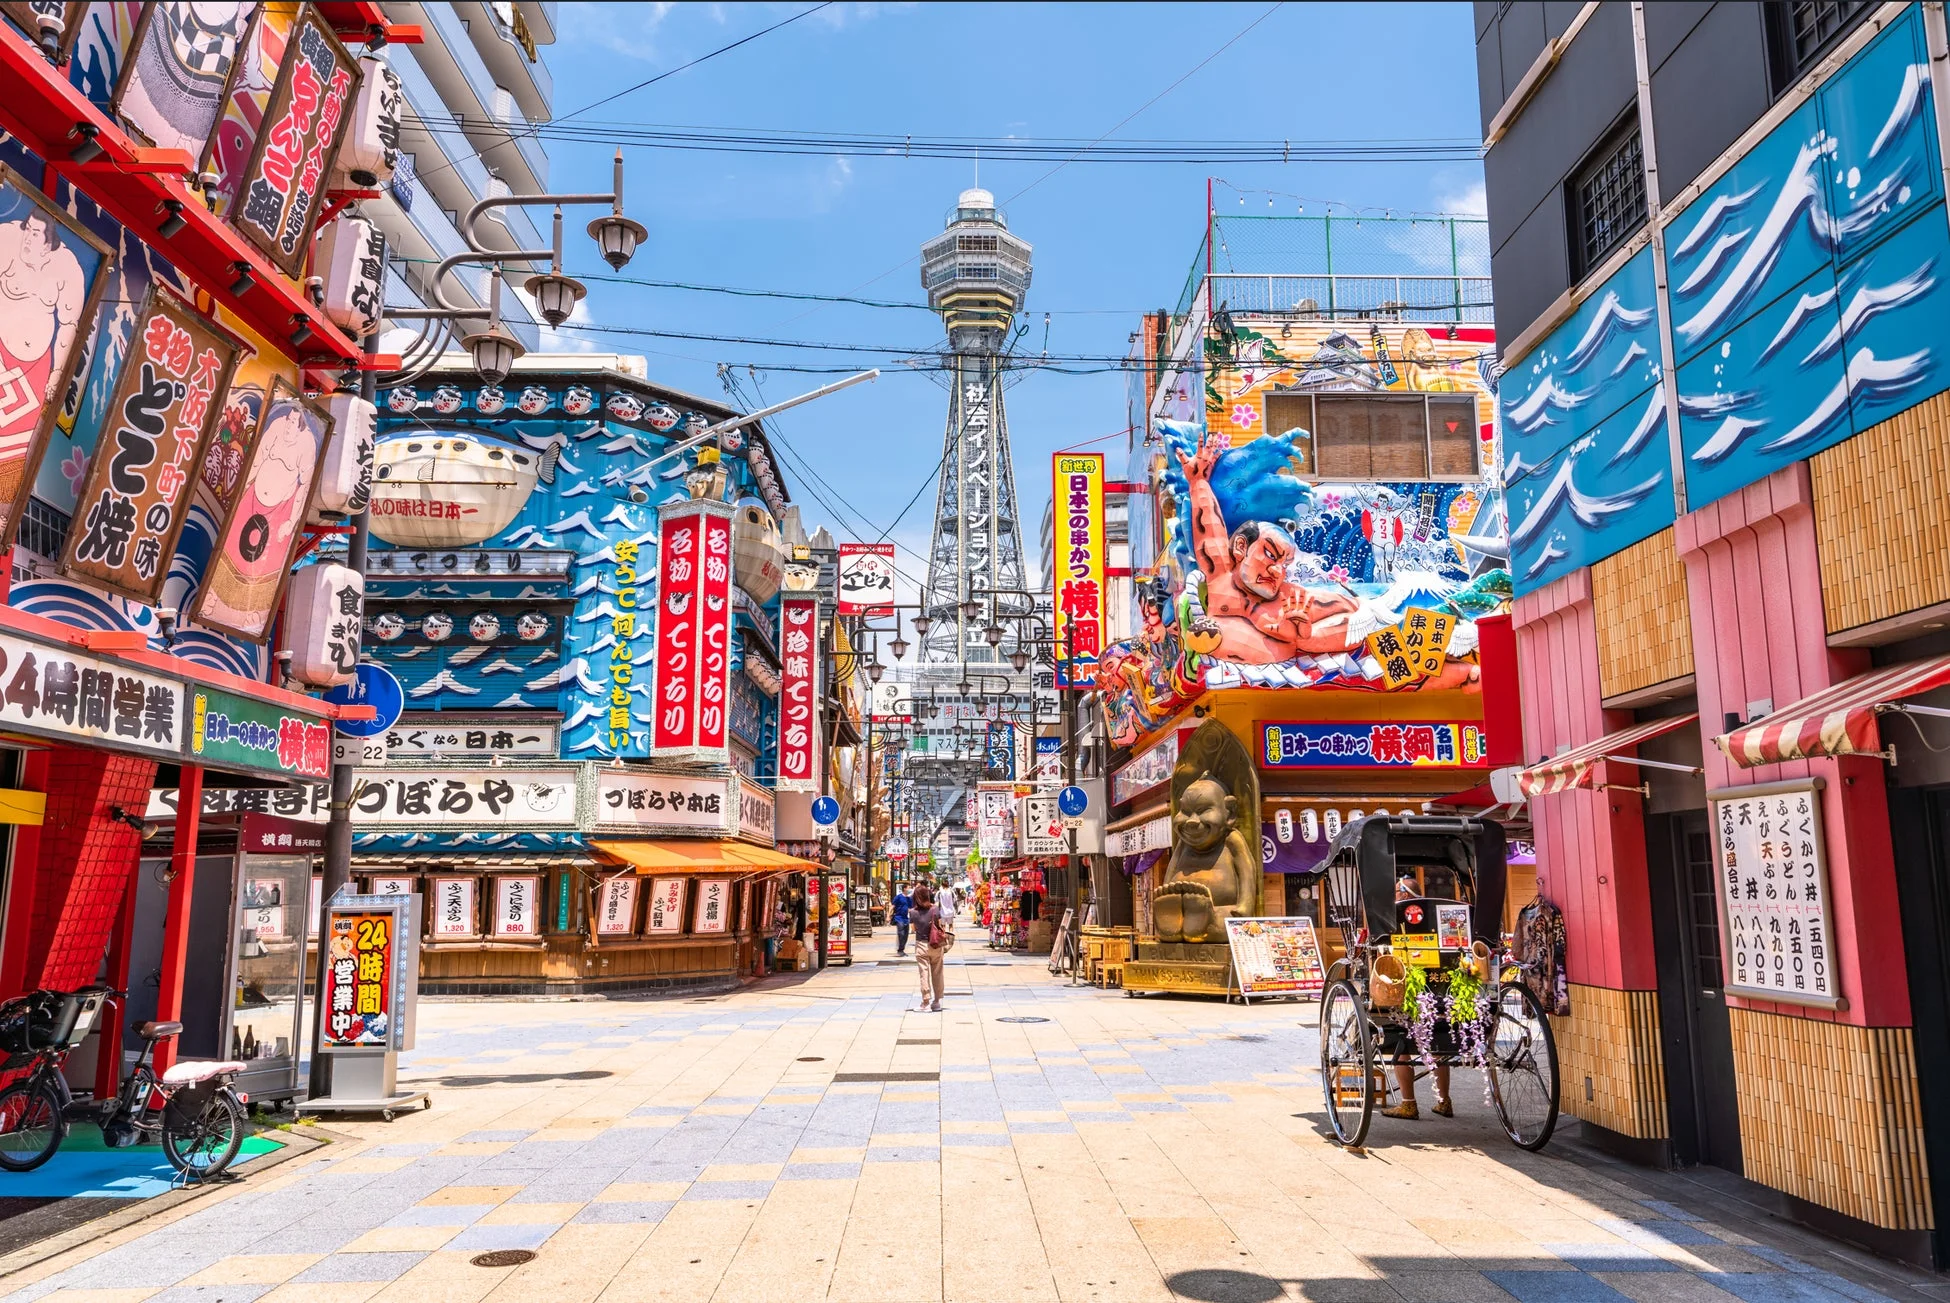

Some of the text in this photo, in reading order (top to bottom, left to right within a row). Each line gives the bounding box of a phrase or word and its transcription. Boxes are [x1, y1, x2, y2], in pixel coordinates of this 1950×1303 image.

[244, 59, 321, 241] ちゃんこ鍋
[146, 315, 192, 377] 名物
[134, 349, 221, 578] 大阪下町の味
[1061, 460, 1096, 473] 新世界
[370, 498, 478, 520] 私の味は日本一
[1069, 475, 1091, 578] 日本一の串かつ
[608, 539, 639, 749] 安うて何んでも旨い
[664, 527, 693, 736] 名物 てっちり
[702, 527, 727, 736] 名物 てっちり
[1060, 580, 1099, 659] 横綱
[1407, 614, 1427, 664] 串かつ
[1425, 618, 1446, 671] 日本一の
[1376, 631, 1412, 683] 横綱
[784, 629, 810, 774] 珍味てっちり
[386, 730, 541, 749] ふぐなら日本一
[1267, 727, 1281, 762] 新世界
[1282, 734, 1369, 756] 日本一の串かつ
[1370, 725, 1435, 762] 横綱
[1436, 727, 1454, 761] 名門
[356, 778, 515, 815] づぼらや
[605, 788, 721, 814] づぼらや本店
[262, 833, 292, 847] 横綱
[1722, 804, 1740, 899] 天ぷら盛合せ
[1758, 802, 1777, 900] えび天ぷら
[1777, 800, 1797, 900] ふぐうどん
[1796, 797, 1818, 901] ふぐかつ丼
[667, 882, 679, 912] おみやげ
[506, 924, 524, 932] 880
[356, 920, 389, 1015] 24時間
[332, 959, 355, 1036] 営業中
